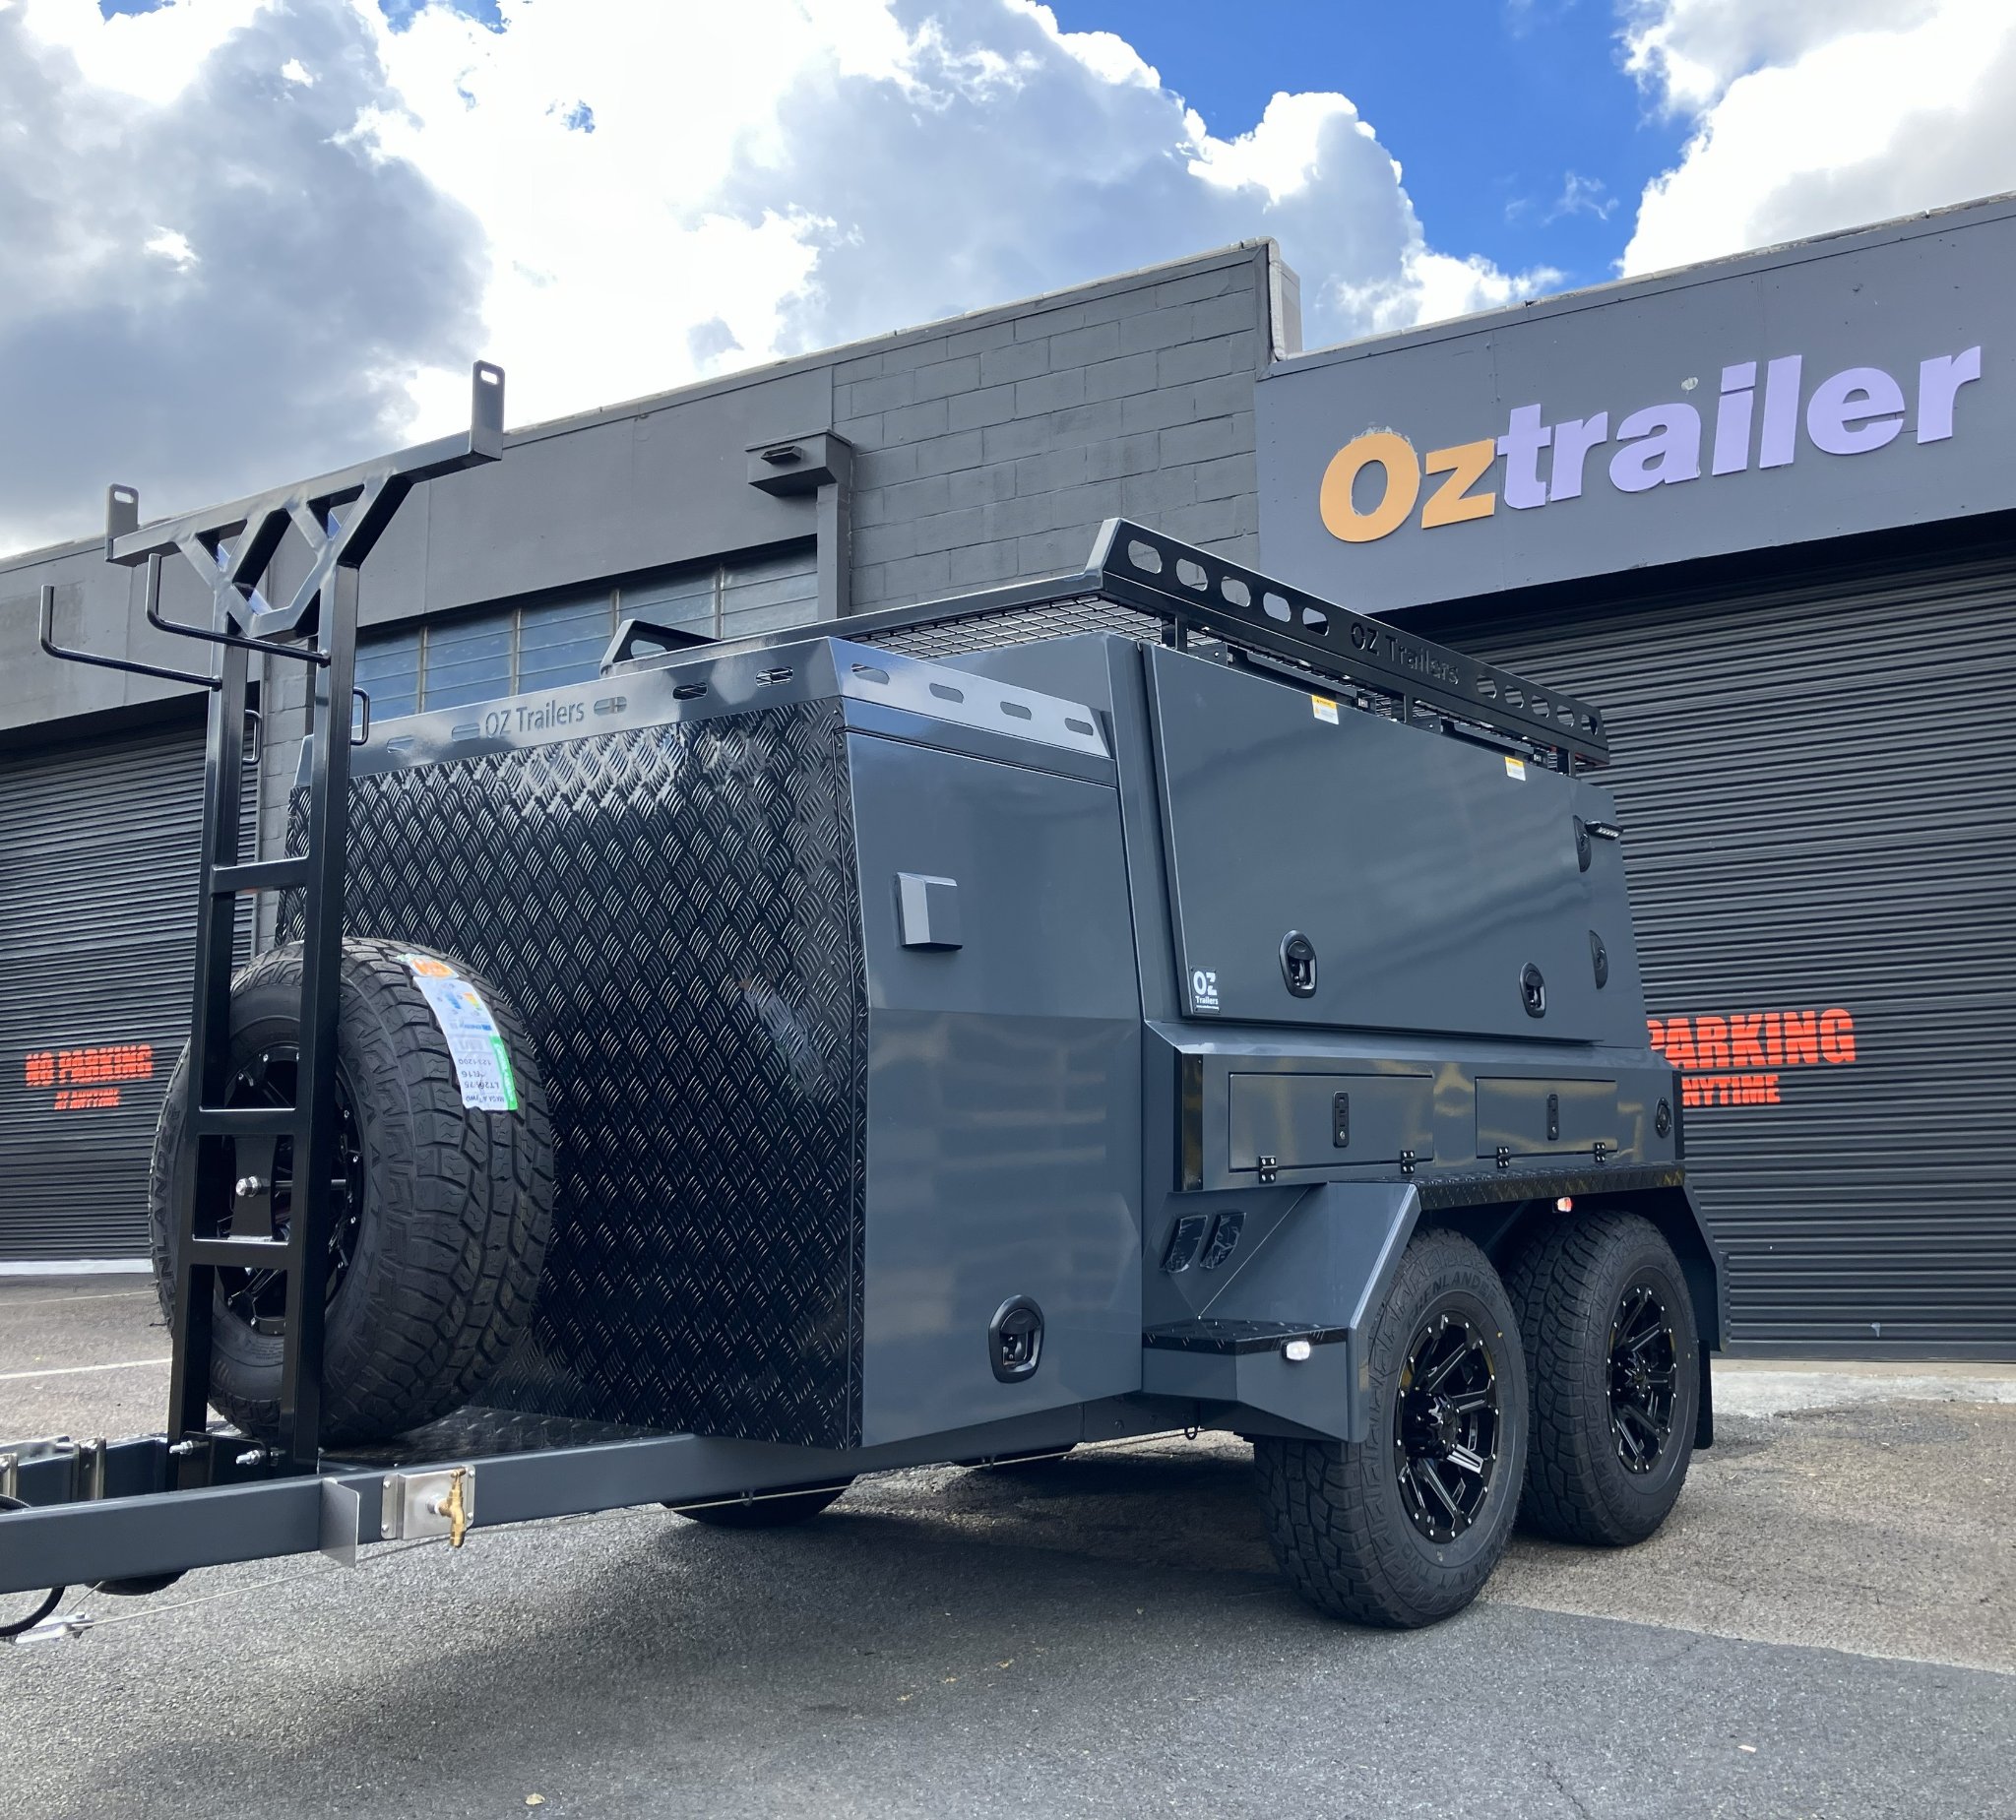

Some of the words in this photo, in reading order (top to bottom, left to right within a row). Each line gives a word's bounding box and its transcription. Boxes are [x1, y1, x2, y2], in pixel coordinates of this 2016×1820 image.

[1320, 345, 1981, 542] Oztrailer
[1352, 622, 1379, 657] OZ
[1385, 635, 1459, 685] Trailers
[485, 709, 511, 737] OZ
[516, 700, 585, 732] Trailers
[1193, 971, 1218, 995] OZ
[1194, 995, 1219, 1005] Trailers
[26, 1052, 53, 1087] NO
[58, 1044, 154, 1084] PARKING
[1681, 1074, 1781, 1106] NYTIME
